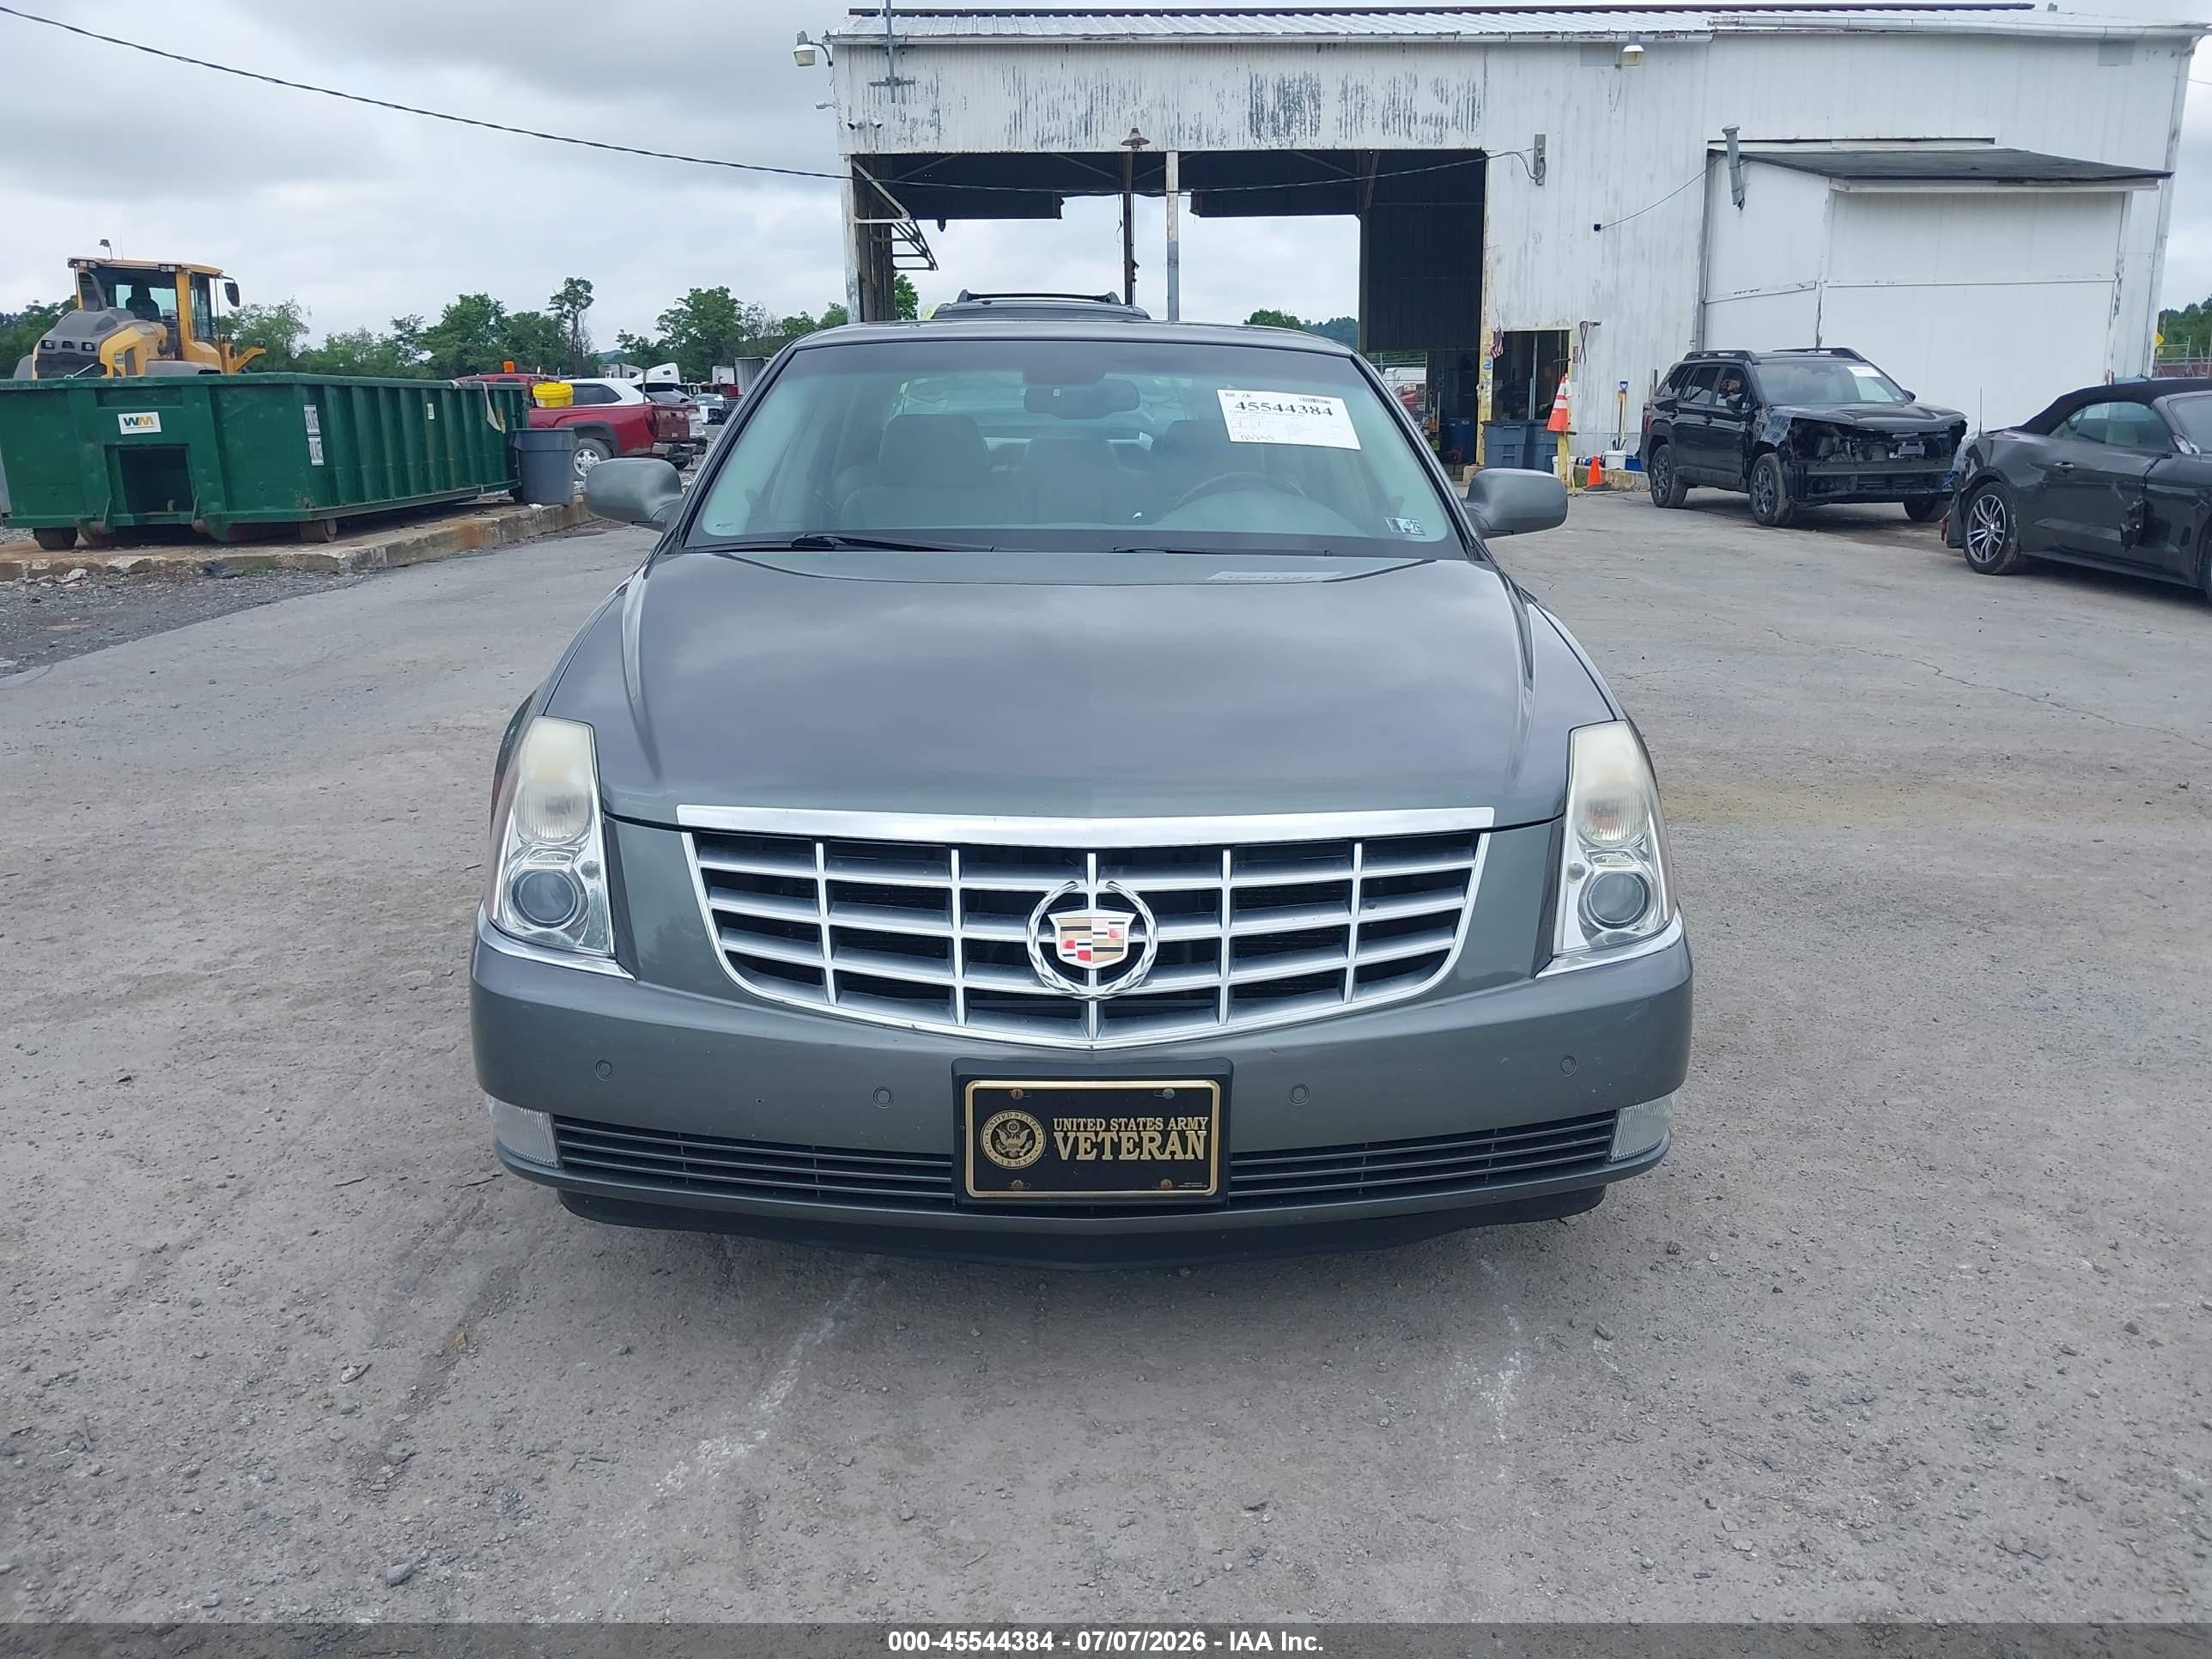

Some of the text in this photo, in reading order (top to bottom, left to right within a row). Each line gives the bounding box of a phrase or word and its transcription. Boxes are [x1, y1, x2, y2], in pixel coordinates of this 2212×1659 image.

[1235, 401, 1333, 416] 45544384
[123, 416, 154, 427] WM
[987, 1112, 1040, 1132] UNITED STATES
[1053, 1116, 1208, 1131] UNITED STATES ARMY
[1053, 1131, 1207, 1160] VETERAN
[1000, 1158, 1027, 1167] ARMY
